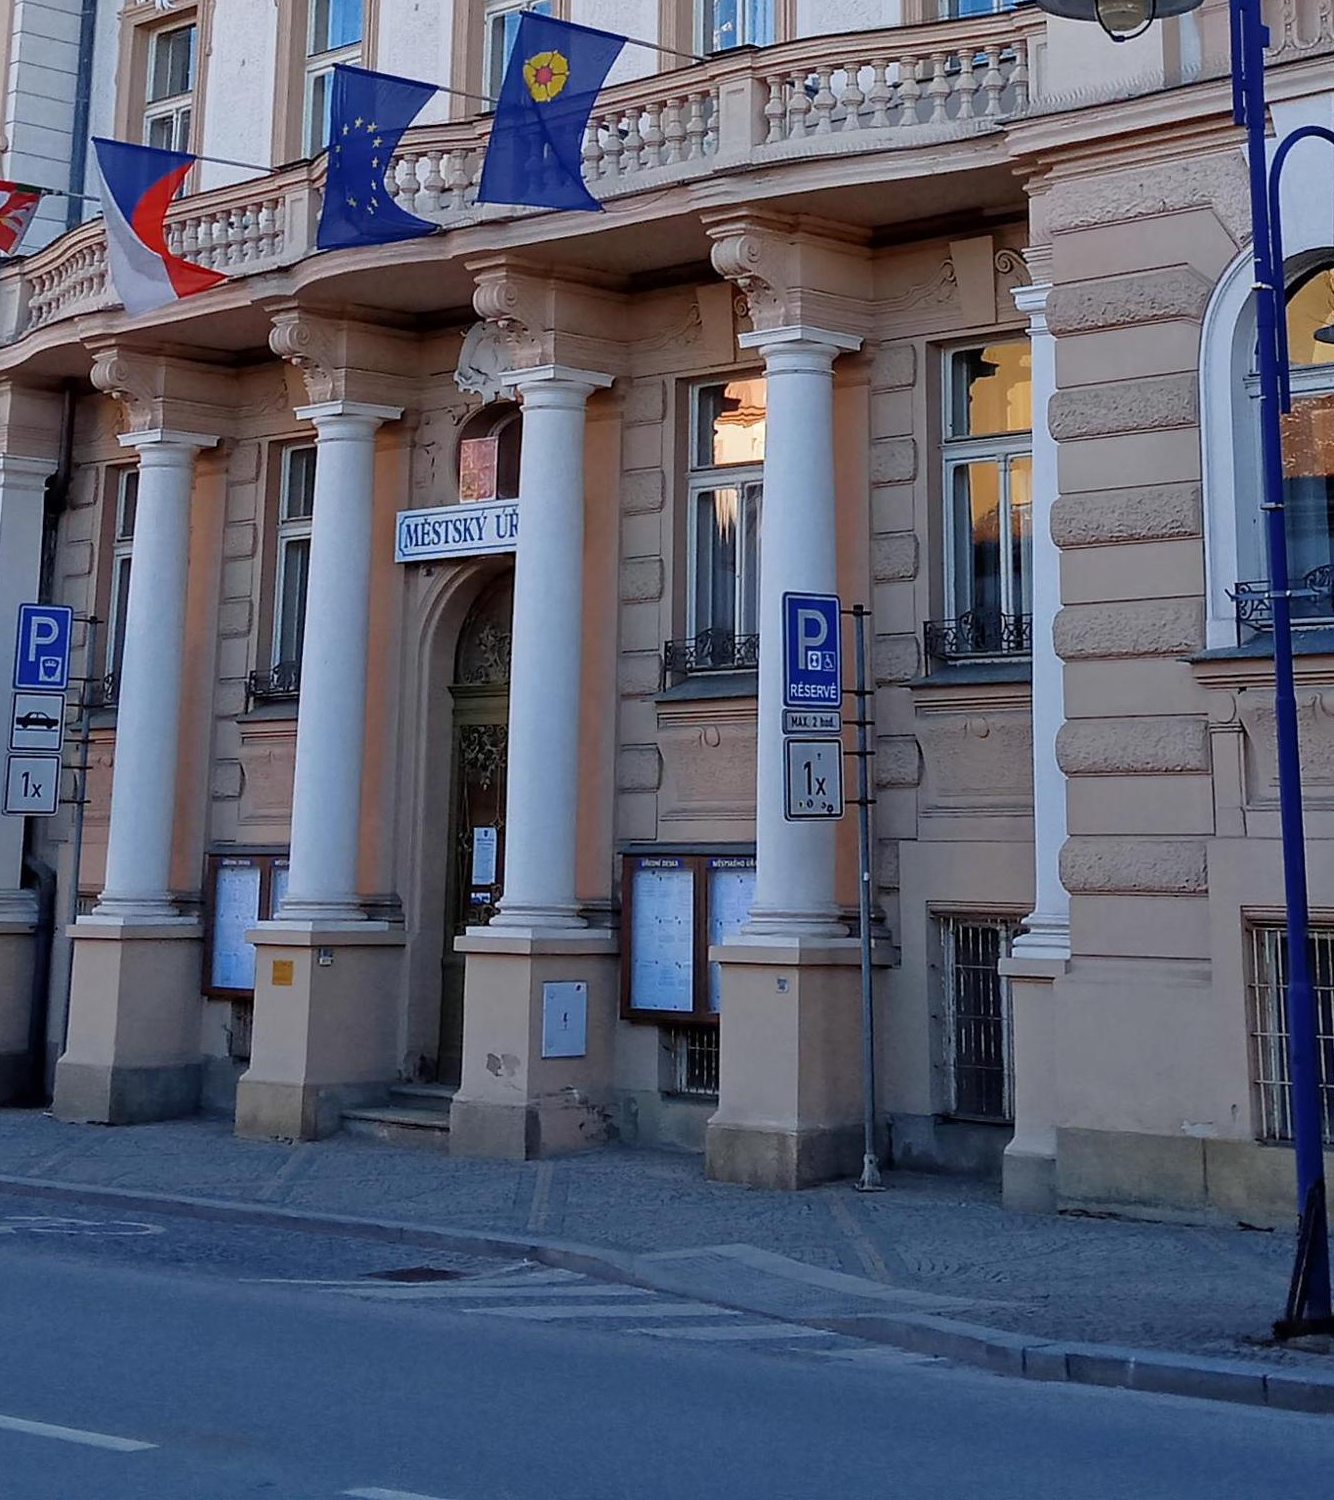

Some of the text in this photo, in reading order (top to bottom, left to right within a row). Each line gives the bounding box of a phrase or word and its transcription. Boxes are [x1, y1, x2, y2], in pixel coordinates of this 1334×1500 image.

[404, 511, 487, 549] MĚSTSKÝ
[28, 616, 59, 661] P
[797, 609, 827, 669] P
[790, 680, 837, 699] RÉSERVÉ
[812, 716, 818, 728] 2
[21, 771, 42, 798] 1x
[803, 760, 826, 796] 1x
